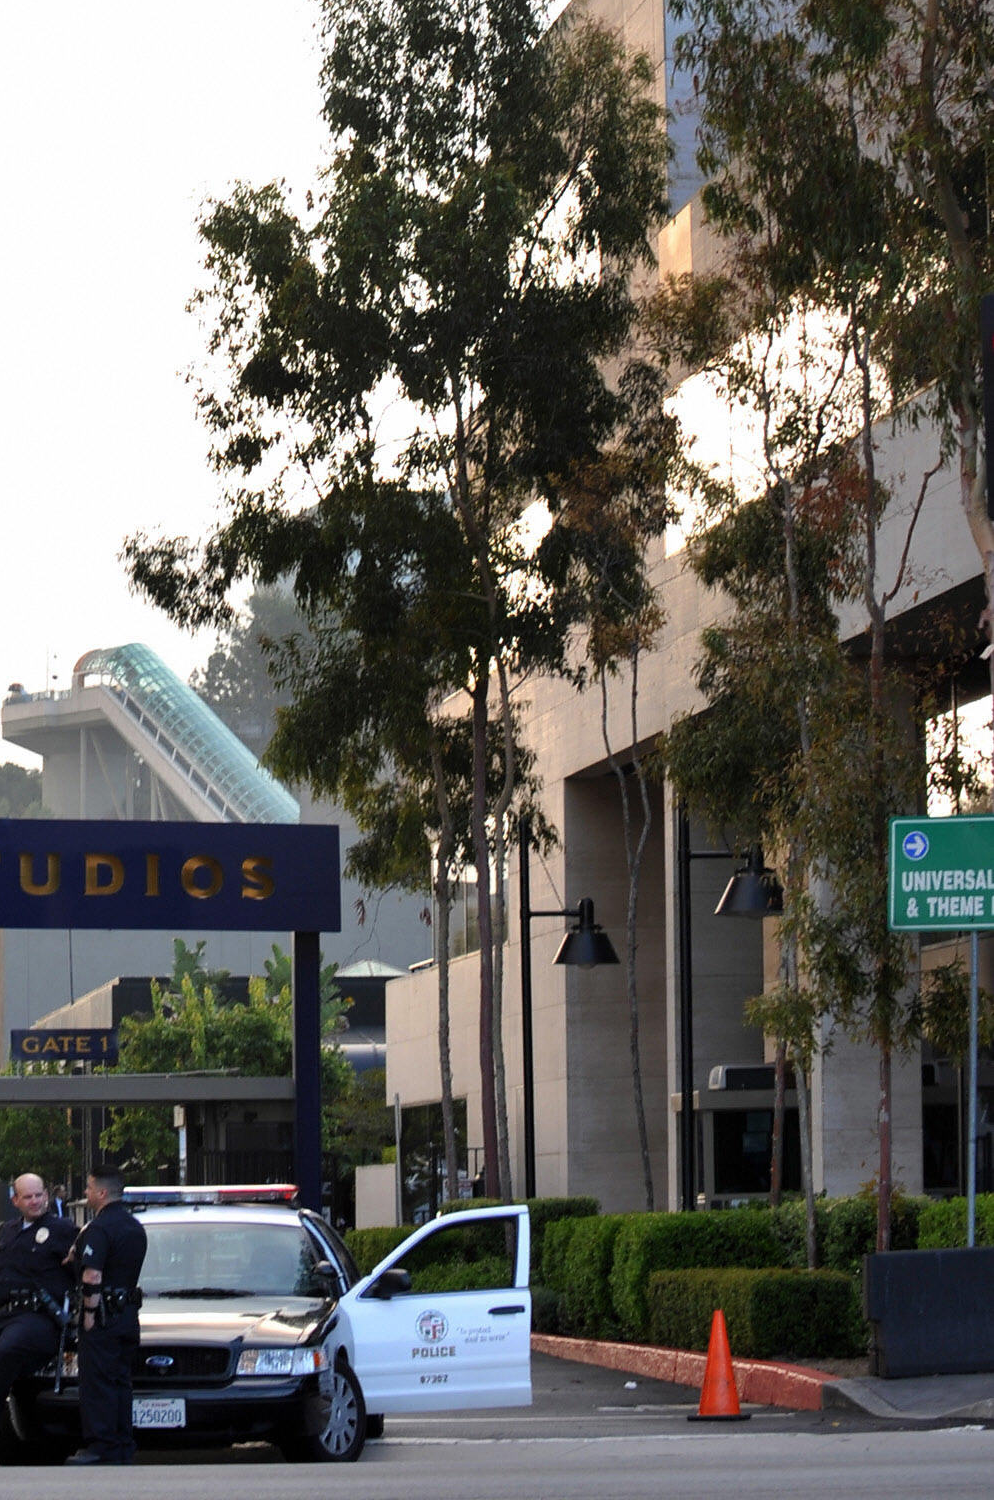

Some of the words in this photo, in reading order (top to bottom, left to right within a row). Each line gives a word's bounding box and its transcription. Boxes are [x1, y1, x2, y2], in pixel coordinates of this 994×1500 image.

[901, 869, 994, 892] UNIVERSAL
[906, 897, 919, 918] &
[927, 895, 984, 918] THEME
[21, 1035, 92, 1054] GATE
[100, 1035, 108, 1053] 1
[411, 1346, 456, 1359] POLICE
